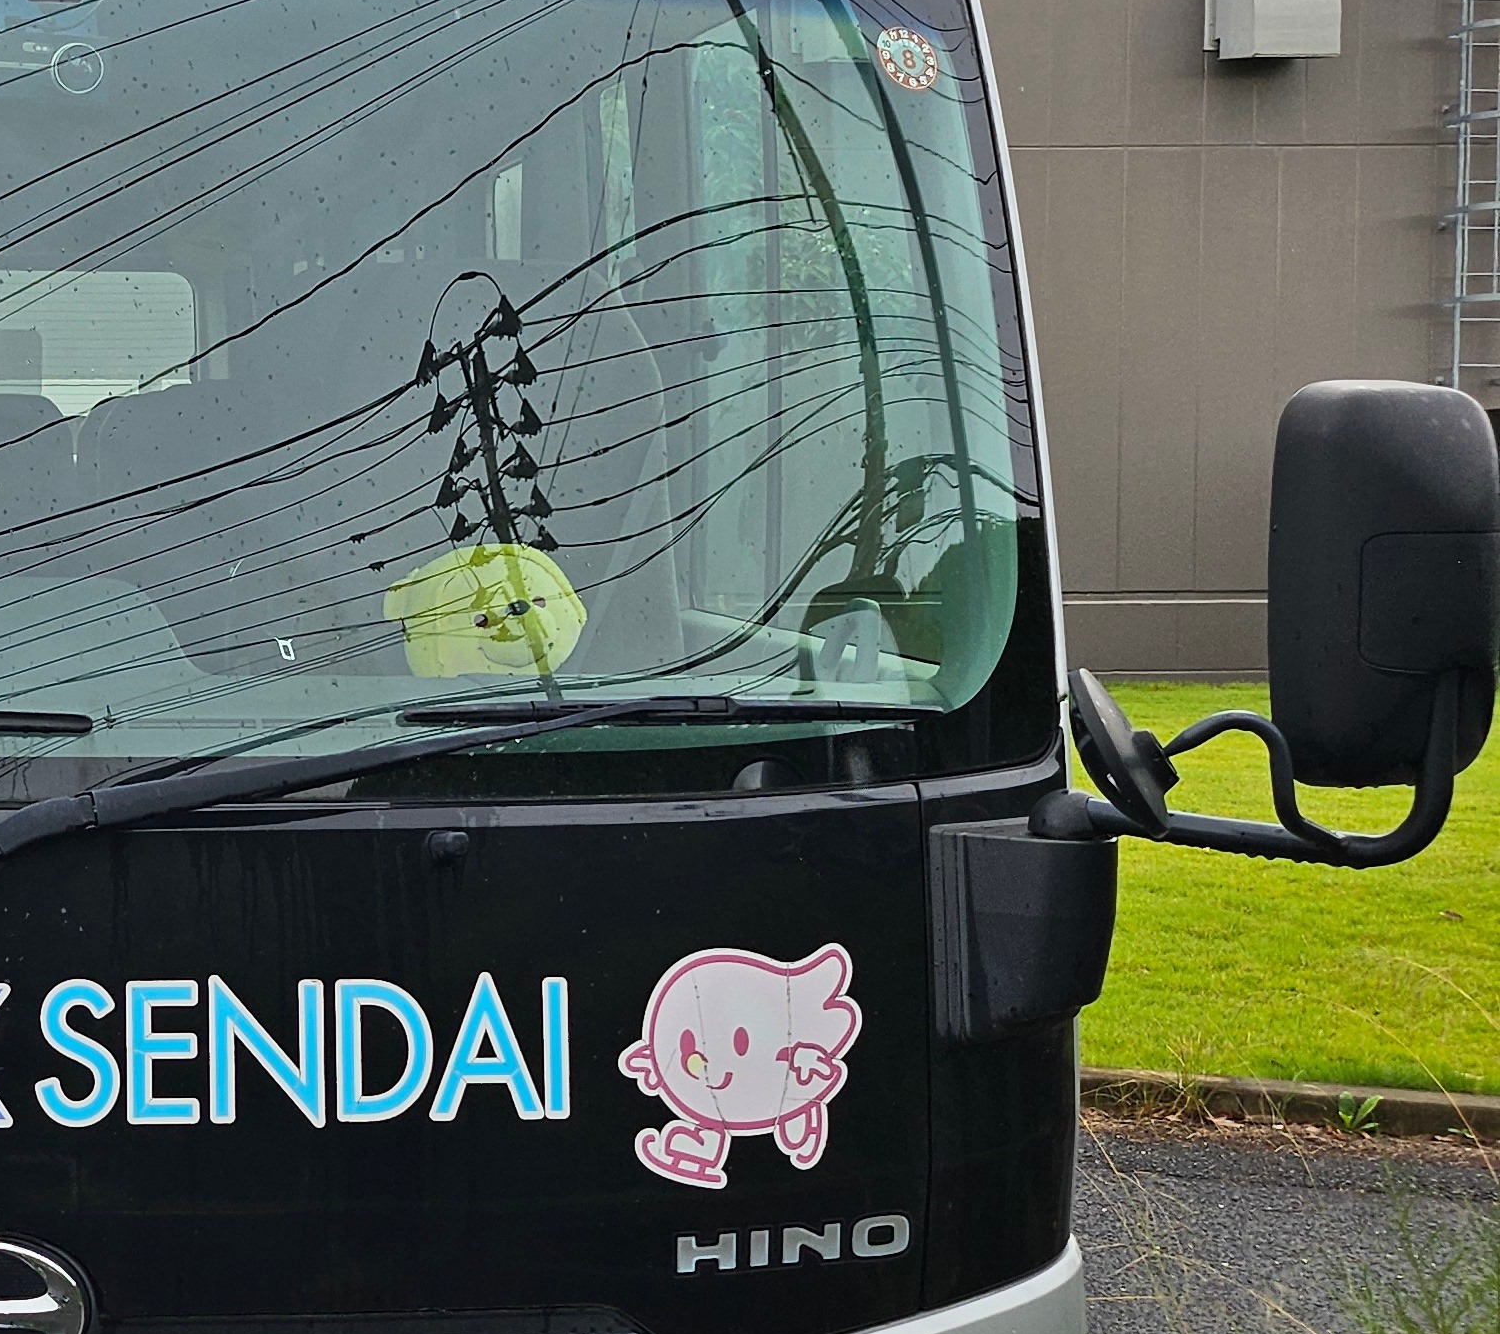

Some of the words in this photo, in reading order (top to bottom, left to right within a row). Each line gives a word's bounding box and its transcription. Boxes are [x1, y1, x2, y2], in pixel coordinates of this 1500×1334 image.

[899, 29, 909, 38] 12
[921, 43, 930, 53] 2
[881, 50, 890, 60] 9
[902, 49, 916, 69] 8
[925, 56, 934, 66] 3
[896, 71, 905, 82] 7
[925, 67, 934, 77] 4
[908, 77, 918, 87] 6
[919, 75, 927, 85] 5
[35, 972, 569, 1128] SENDAI
[676, 1213, 911, 1274] HINO
